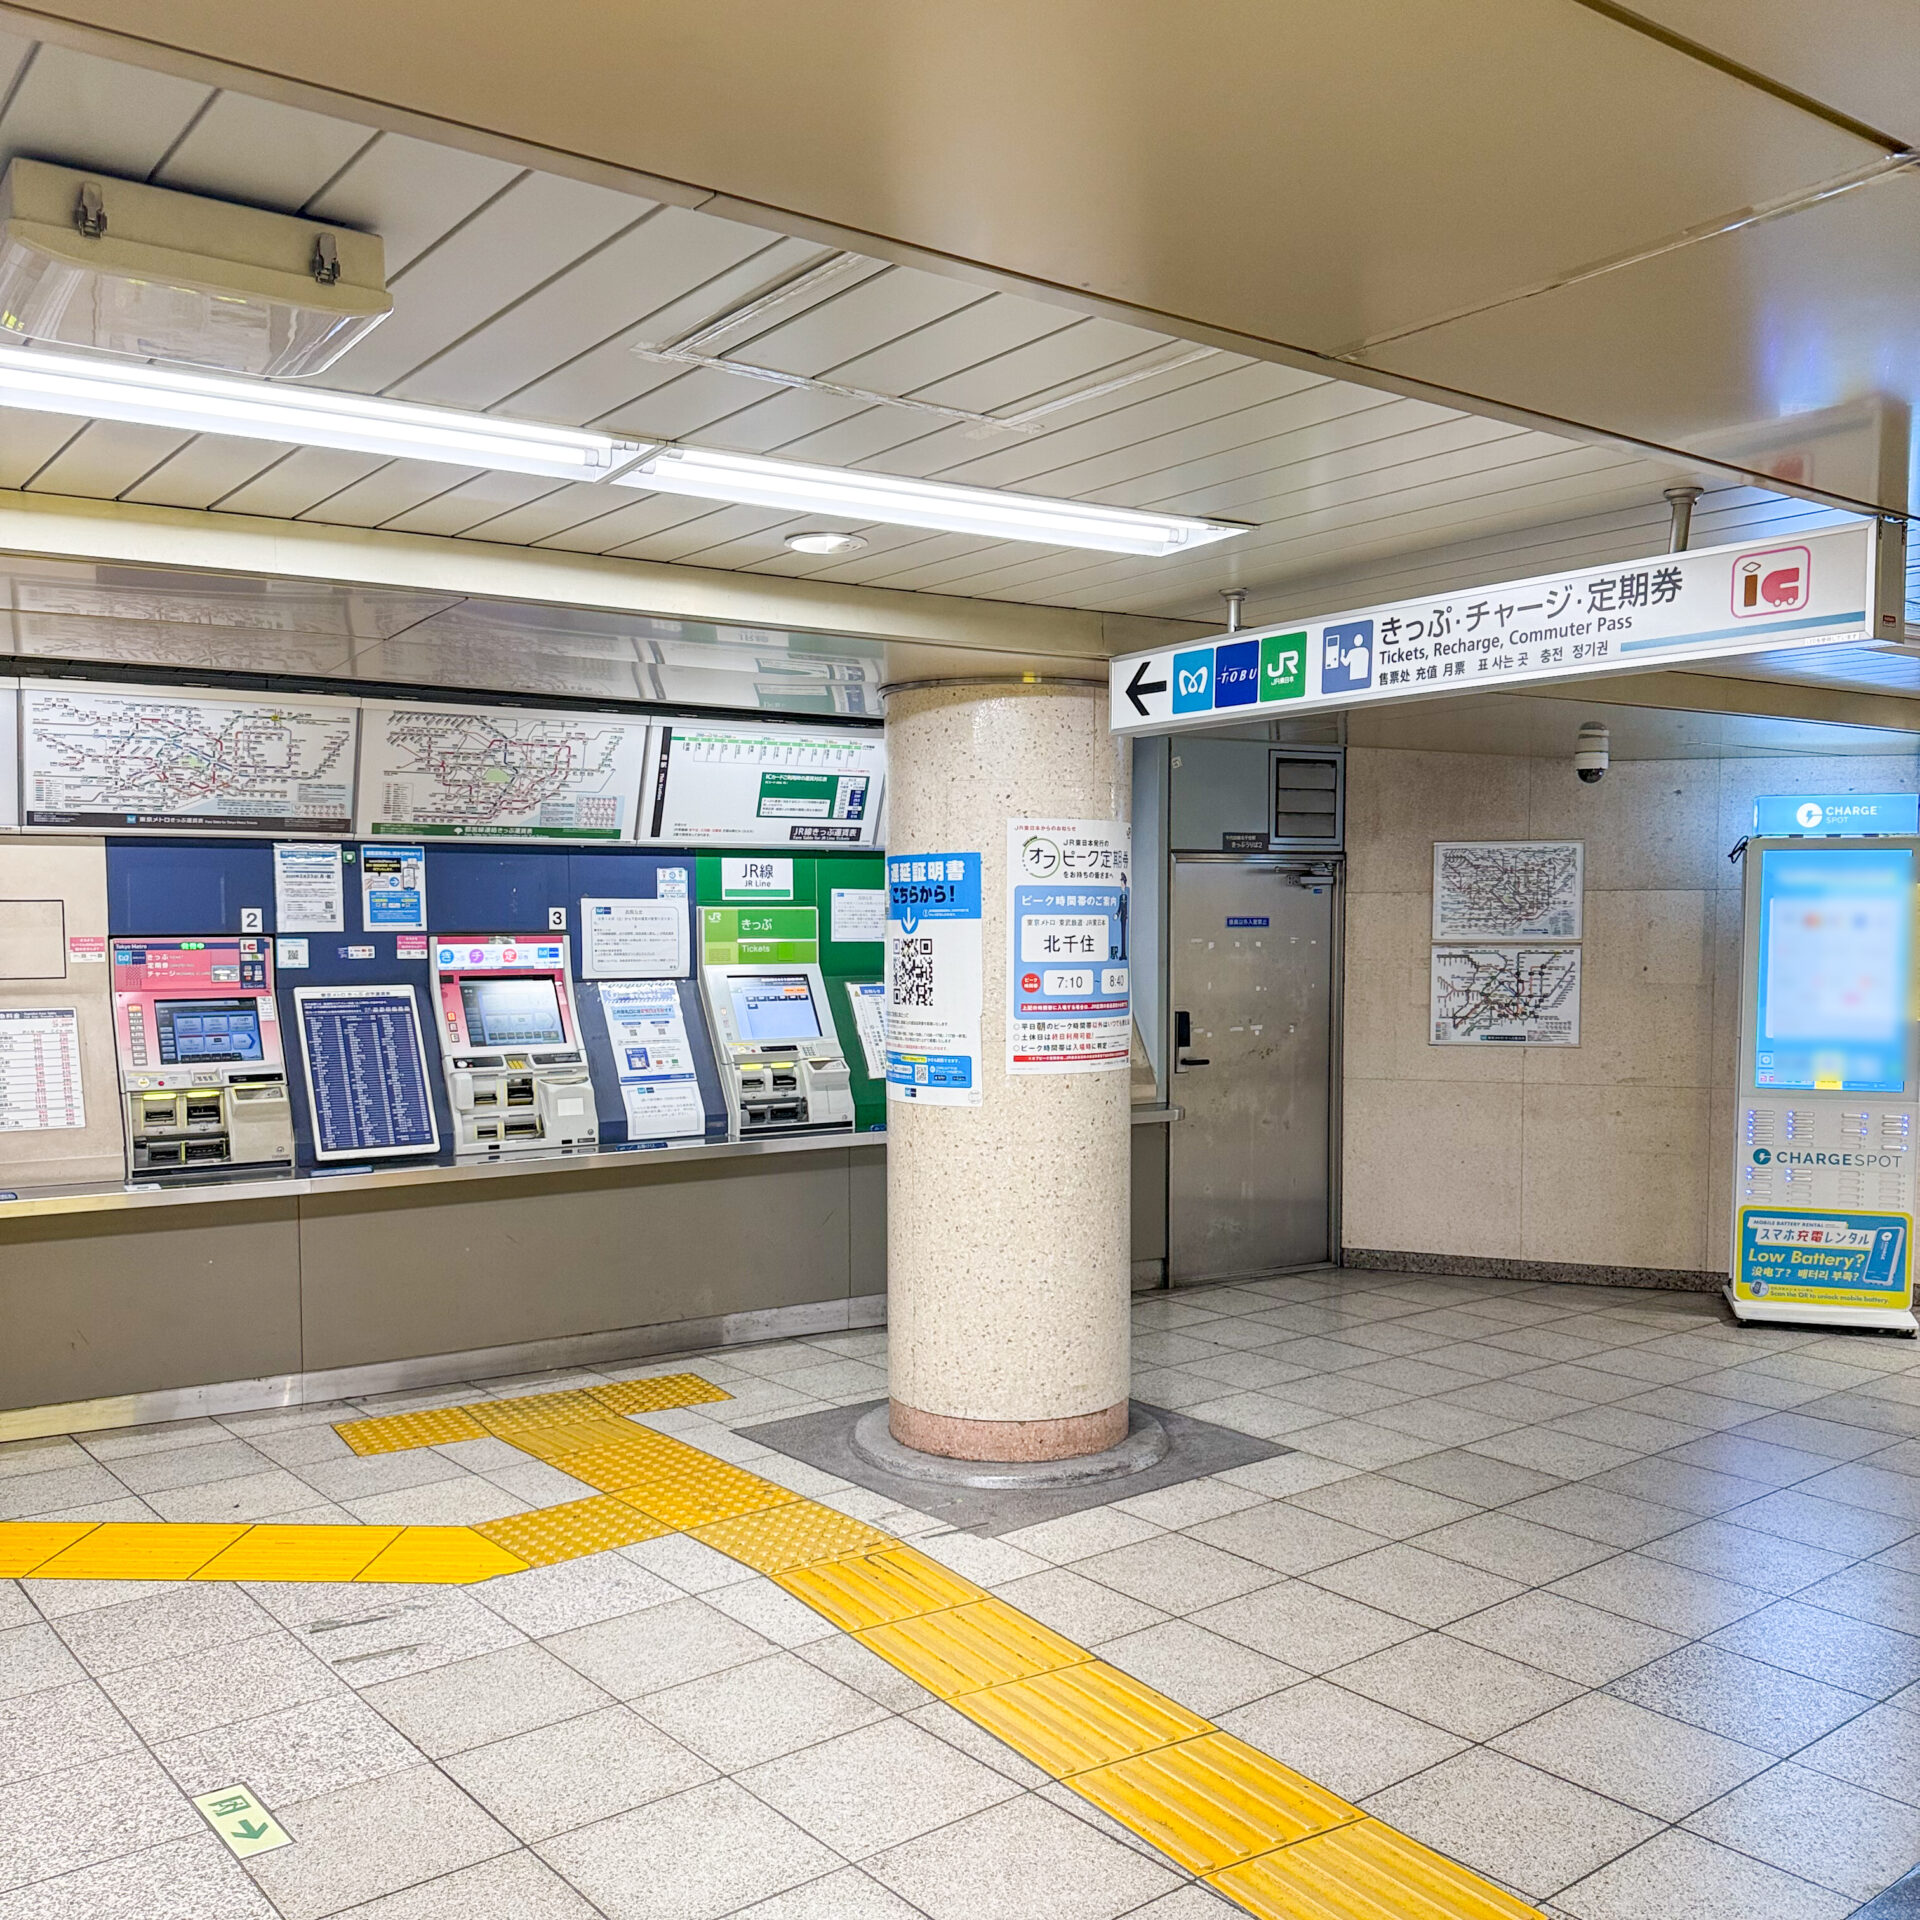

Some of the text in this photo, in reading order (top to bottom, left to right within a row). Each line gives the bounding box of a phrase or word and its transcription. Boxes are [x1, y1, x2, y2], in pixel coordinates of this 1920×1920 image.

[1379, 614, 1633, 665] Tickets, Recharge, Commuter Pass
[1540, 645, 1563, 664] 충전
[1572, 639, 1609, 660] 정기권
[1267, 650, 1300, 678] JR
[1216, 667, 1257, 685] TOBU
[1378, 660, 1466, 686] 售票处 充值 月票
[1825, 806, 1878, 816] CHARGE
[1825, 816, 1849, 824] SPOT
[742, 864, 774, 879] JR線
[755, 879, 771, 887] Line
[1022, 895, 1117, 906] ピーク時間帯のご案内
[245, 912, 258, 929] 2
[551, 910, 564, 926] 3
[708, 912, 722, 921] JR
[741, 918, 773, 931] きっぷ
[741, 944, 771, 953] Tickets
[1043, 934, 1095, 953] 北千住
[1057, 974, 1125, 988] 7:10 8:40
[1776, 1151, 1903, 1168] CHARGESPOT
[1760, 1228, 1869, 1246] スマホ充電レンタル
[1748, 1248, 1866, 1270] Low Battery?
